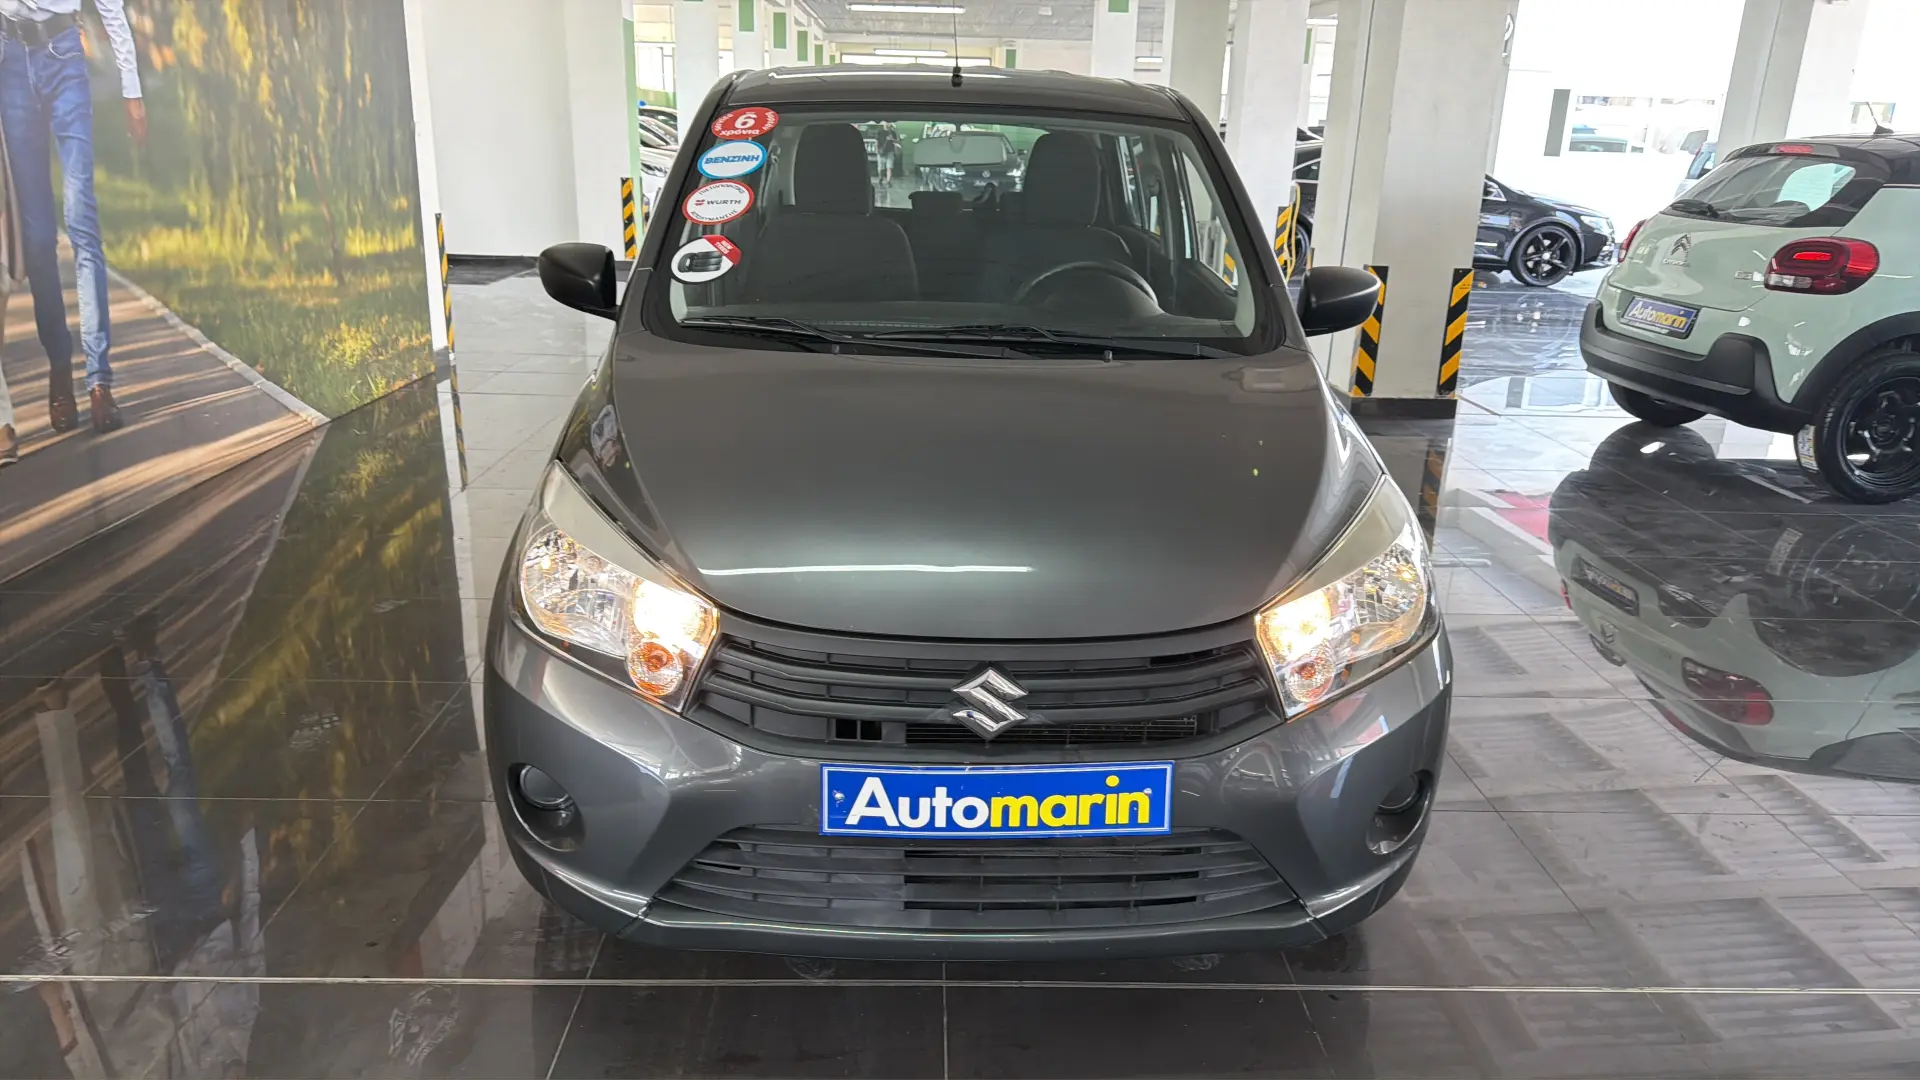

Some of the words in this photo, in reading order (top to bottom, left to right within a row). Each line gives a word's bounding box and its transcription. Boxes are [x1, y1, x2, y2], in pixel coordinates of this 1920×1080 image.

[720, 128, 760, 137] χρόνια
[735, 114, 757, 129] 6
[1628, 300, 1688, 329] Automarin
[844, 775, 1150, 828] Automarin
